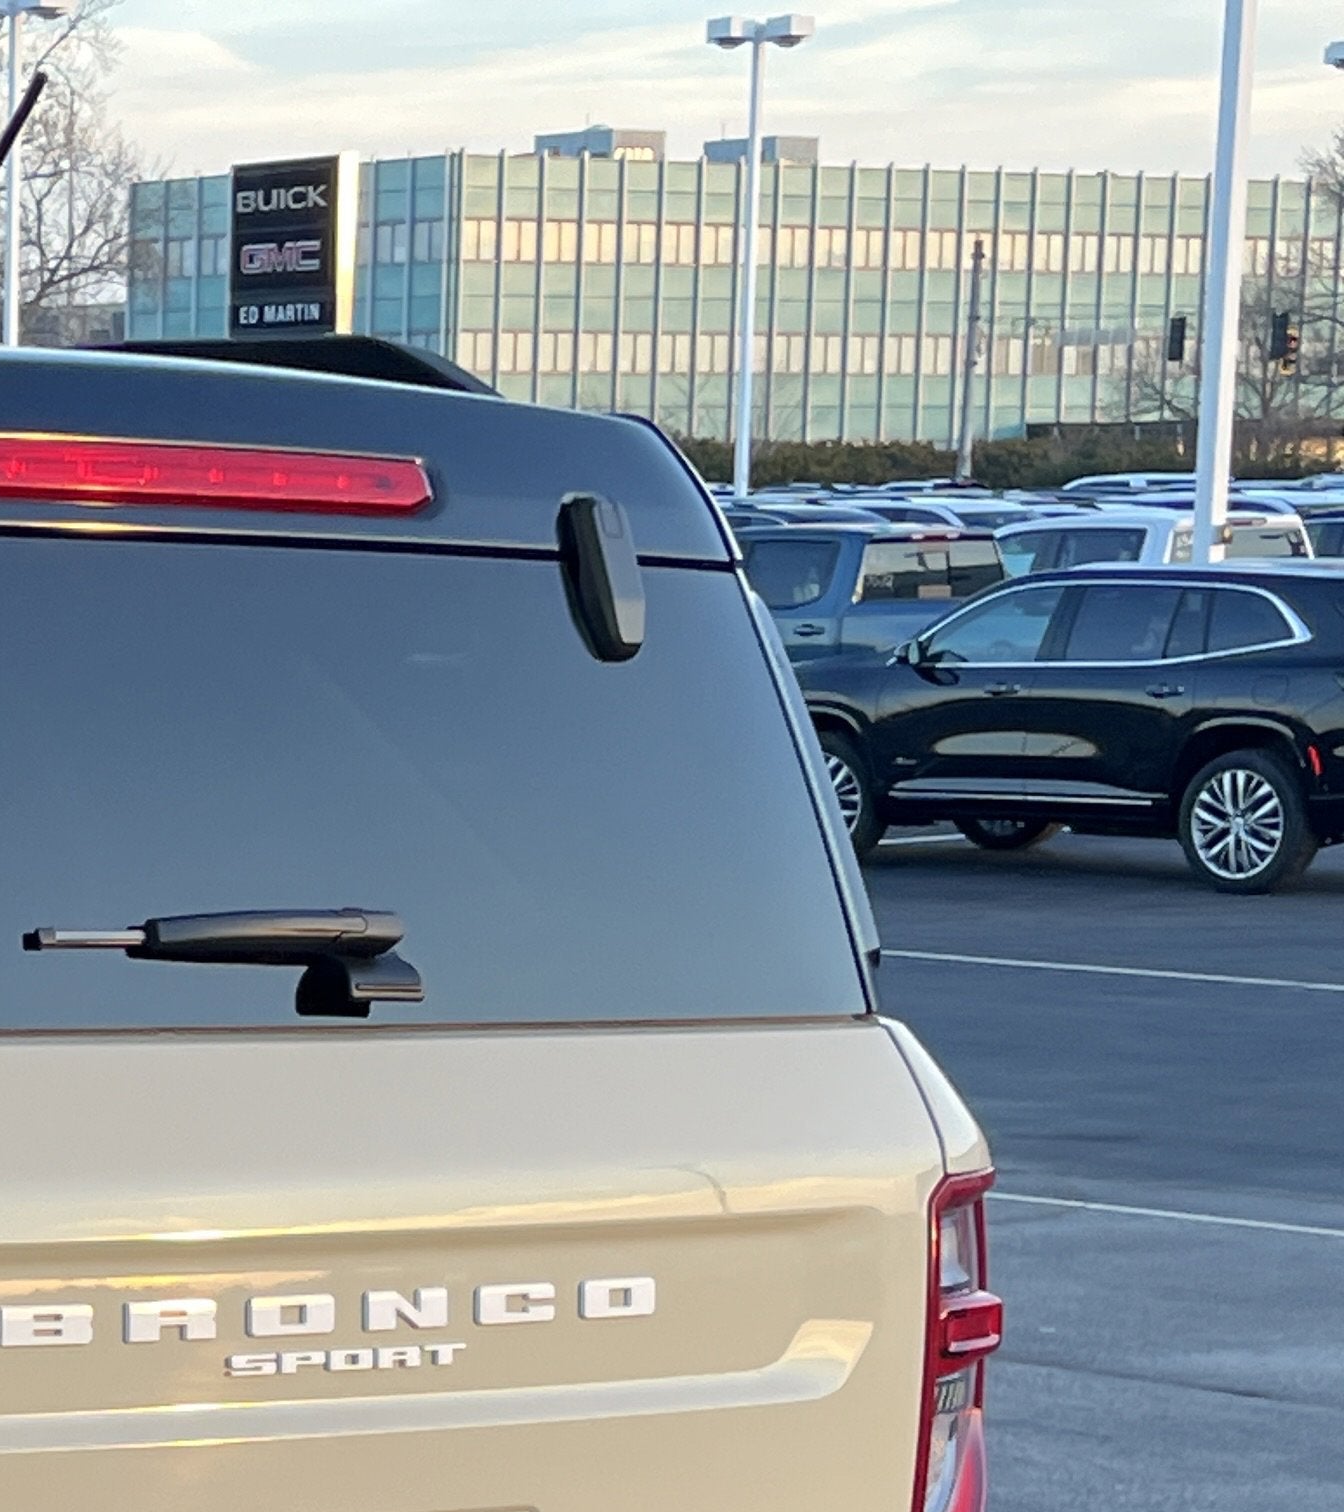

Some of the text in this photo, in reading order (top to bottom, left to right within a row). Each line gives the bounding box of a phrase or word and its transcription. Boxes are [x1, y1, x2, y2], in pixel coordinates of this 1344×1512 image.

[236, 184, 328, 213] BUICK
[240, 240, 321, 274] GMC
[239, 303, 320, 324] ED MARTIN
[224, 1342, 467, 1377] SPORT
